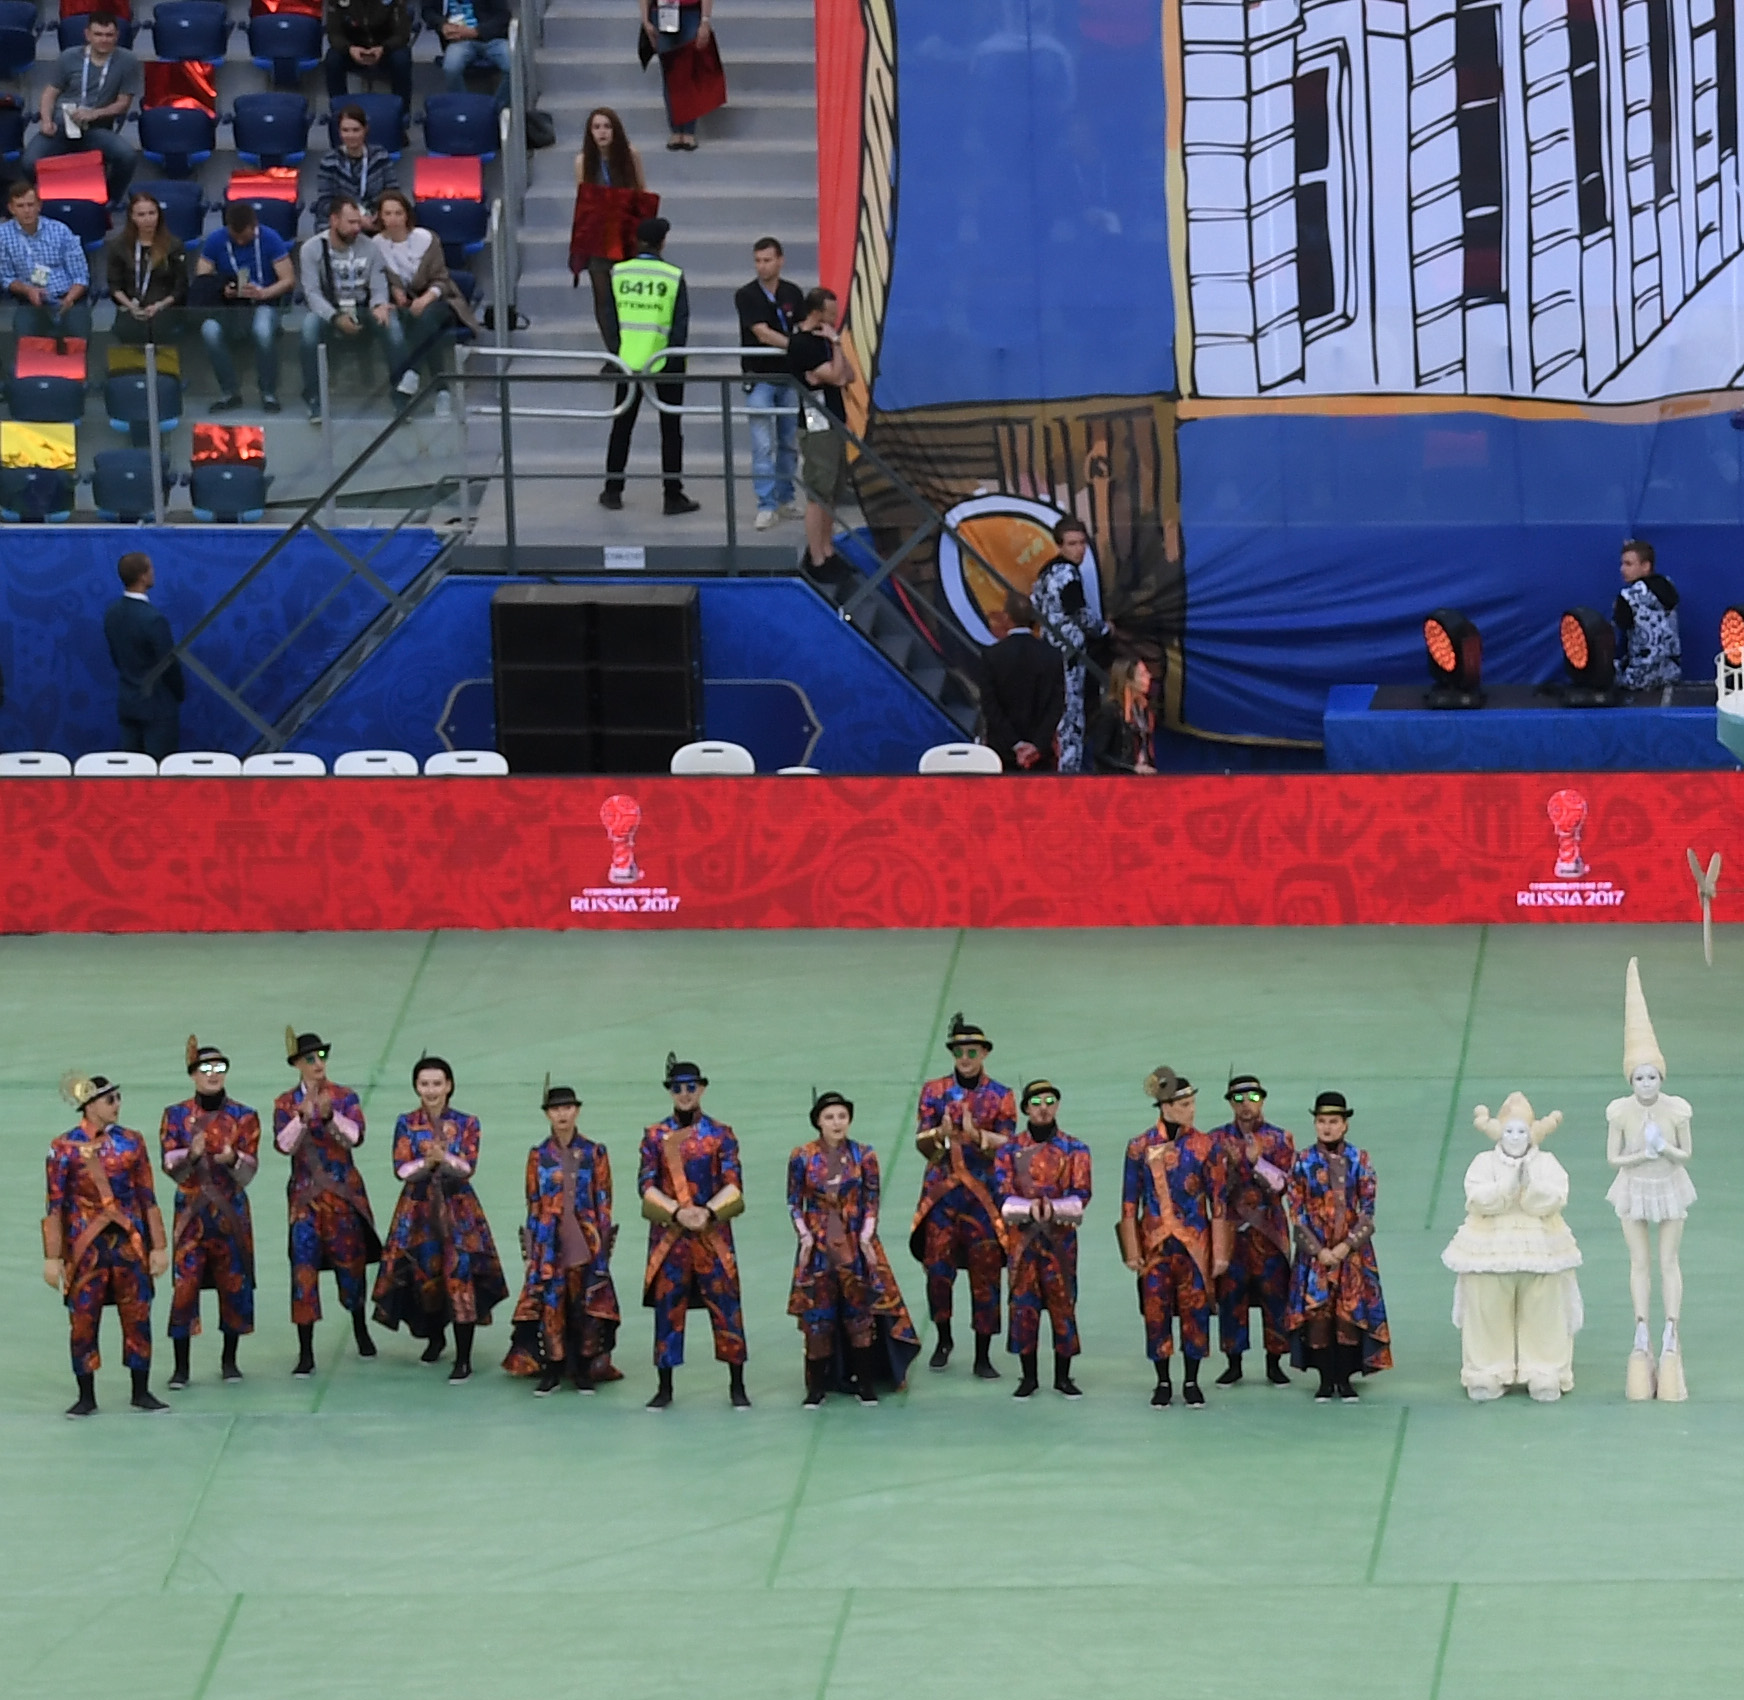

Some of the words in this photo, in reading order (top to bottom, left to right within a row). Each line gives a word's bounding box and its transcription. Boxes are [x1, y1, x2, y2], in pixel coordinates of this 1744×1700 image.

[571, 896, 638, 912] RUSSIA
[639, 896, 681, 912] 2017
[1517, 890, 1583, 906] RUSSIA
[1584, 889, 1625, 906] 2017
